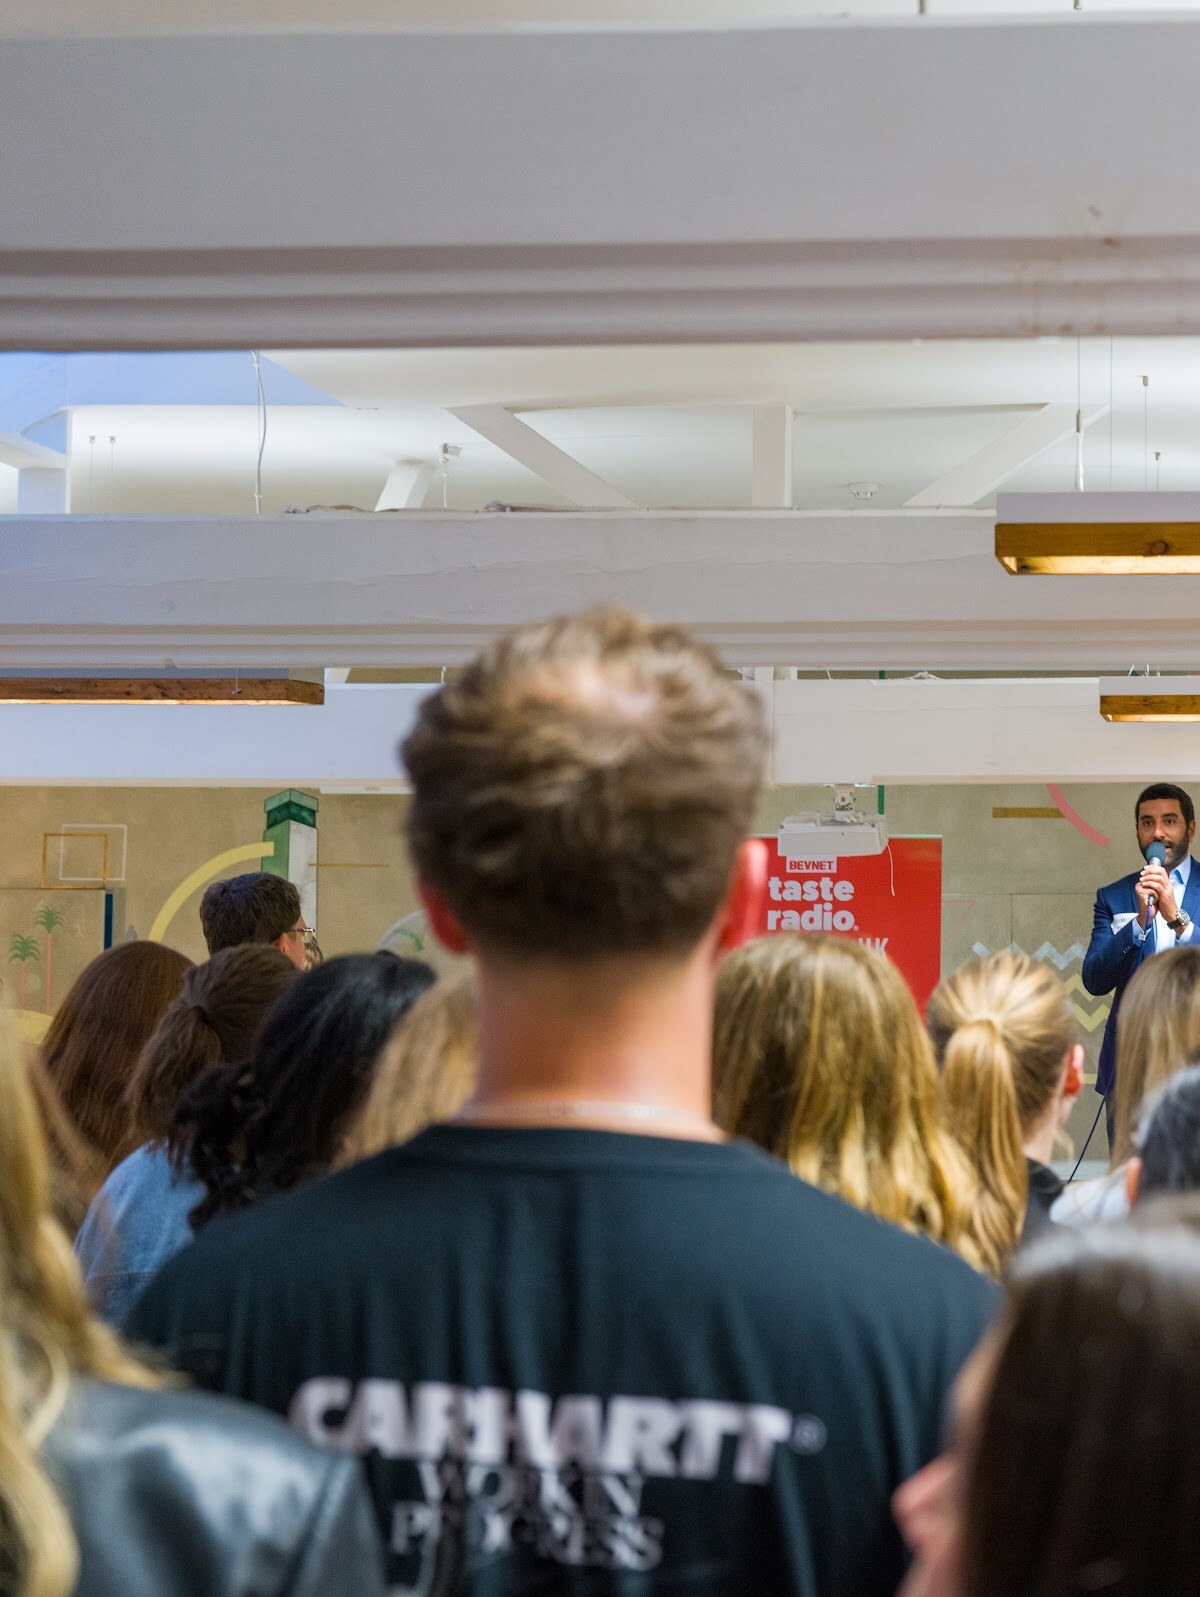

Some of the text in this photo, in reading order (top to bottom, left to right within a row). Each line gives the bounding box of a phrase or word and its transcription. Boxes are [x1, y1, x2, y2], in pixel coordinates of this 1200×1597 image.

[790, 861, 833, 870] BEVNET
[769, 877, 855, 901] taste
[767, 902, 859, 931] radio.
